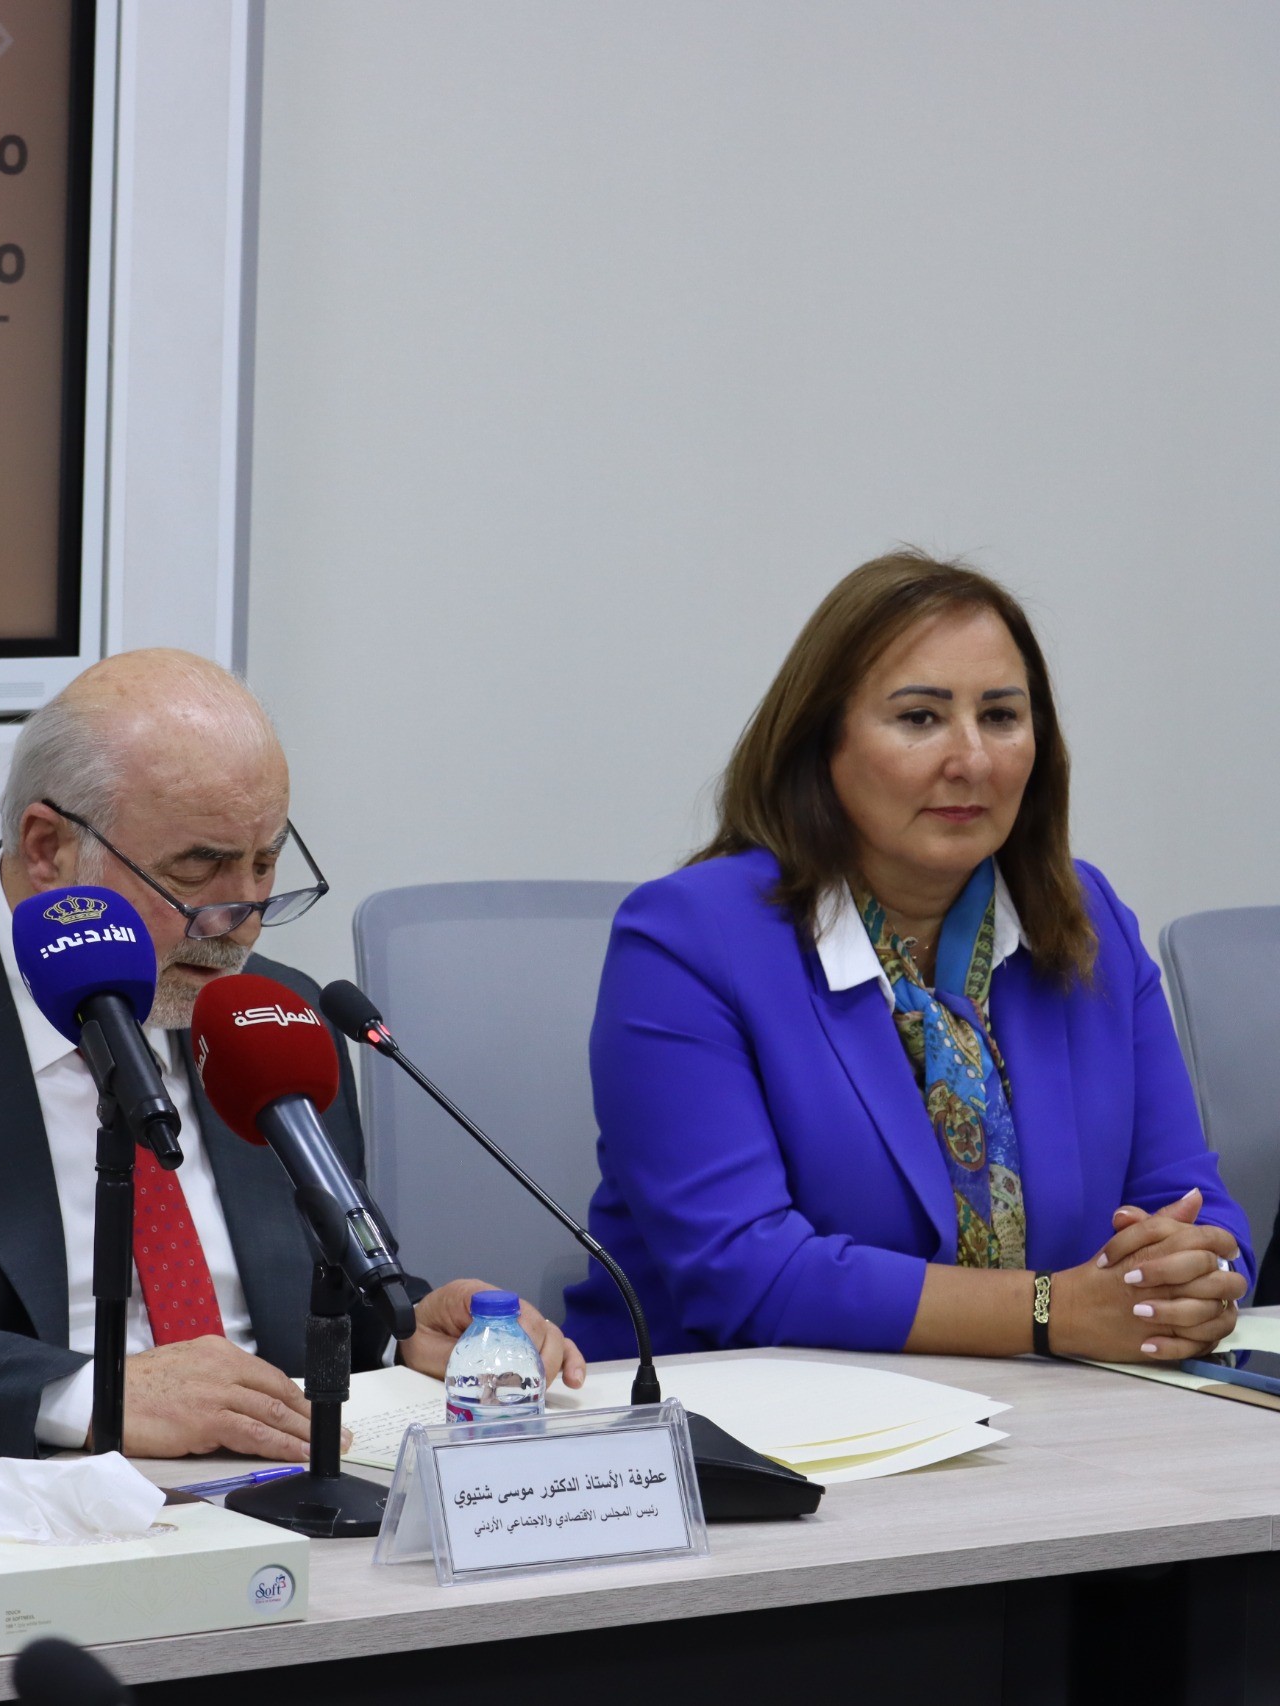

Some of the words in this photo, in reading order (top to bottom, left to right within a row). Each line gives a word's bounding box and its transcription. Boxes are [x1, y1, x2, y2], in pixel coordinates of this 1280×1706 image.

[40, 924, 136, 959] الأردني
[232, 1004, 320, 1026] المملكة
[540, 1476, 580, 1499] الدكتور
[585, 1469, 624, 1491] الأستاذ
[628, 1468, 668, 1489] عطوفة
[453, 1484, 493, 1509] شتيوي
[497, 1488, 534, 1504] موسى
[555, 1509, 597, 1528] الاقتصادي
[600, 1506, 632, 1522] المجلس
[635, 1505, 659, 1517] رئيس
[473, 1516, 503, 1538] الأردني
[506, 1514, 553, 1534] والاجتماعي
[255, 1582, 281, 1599] Soft
